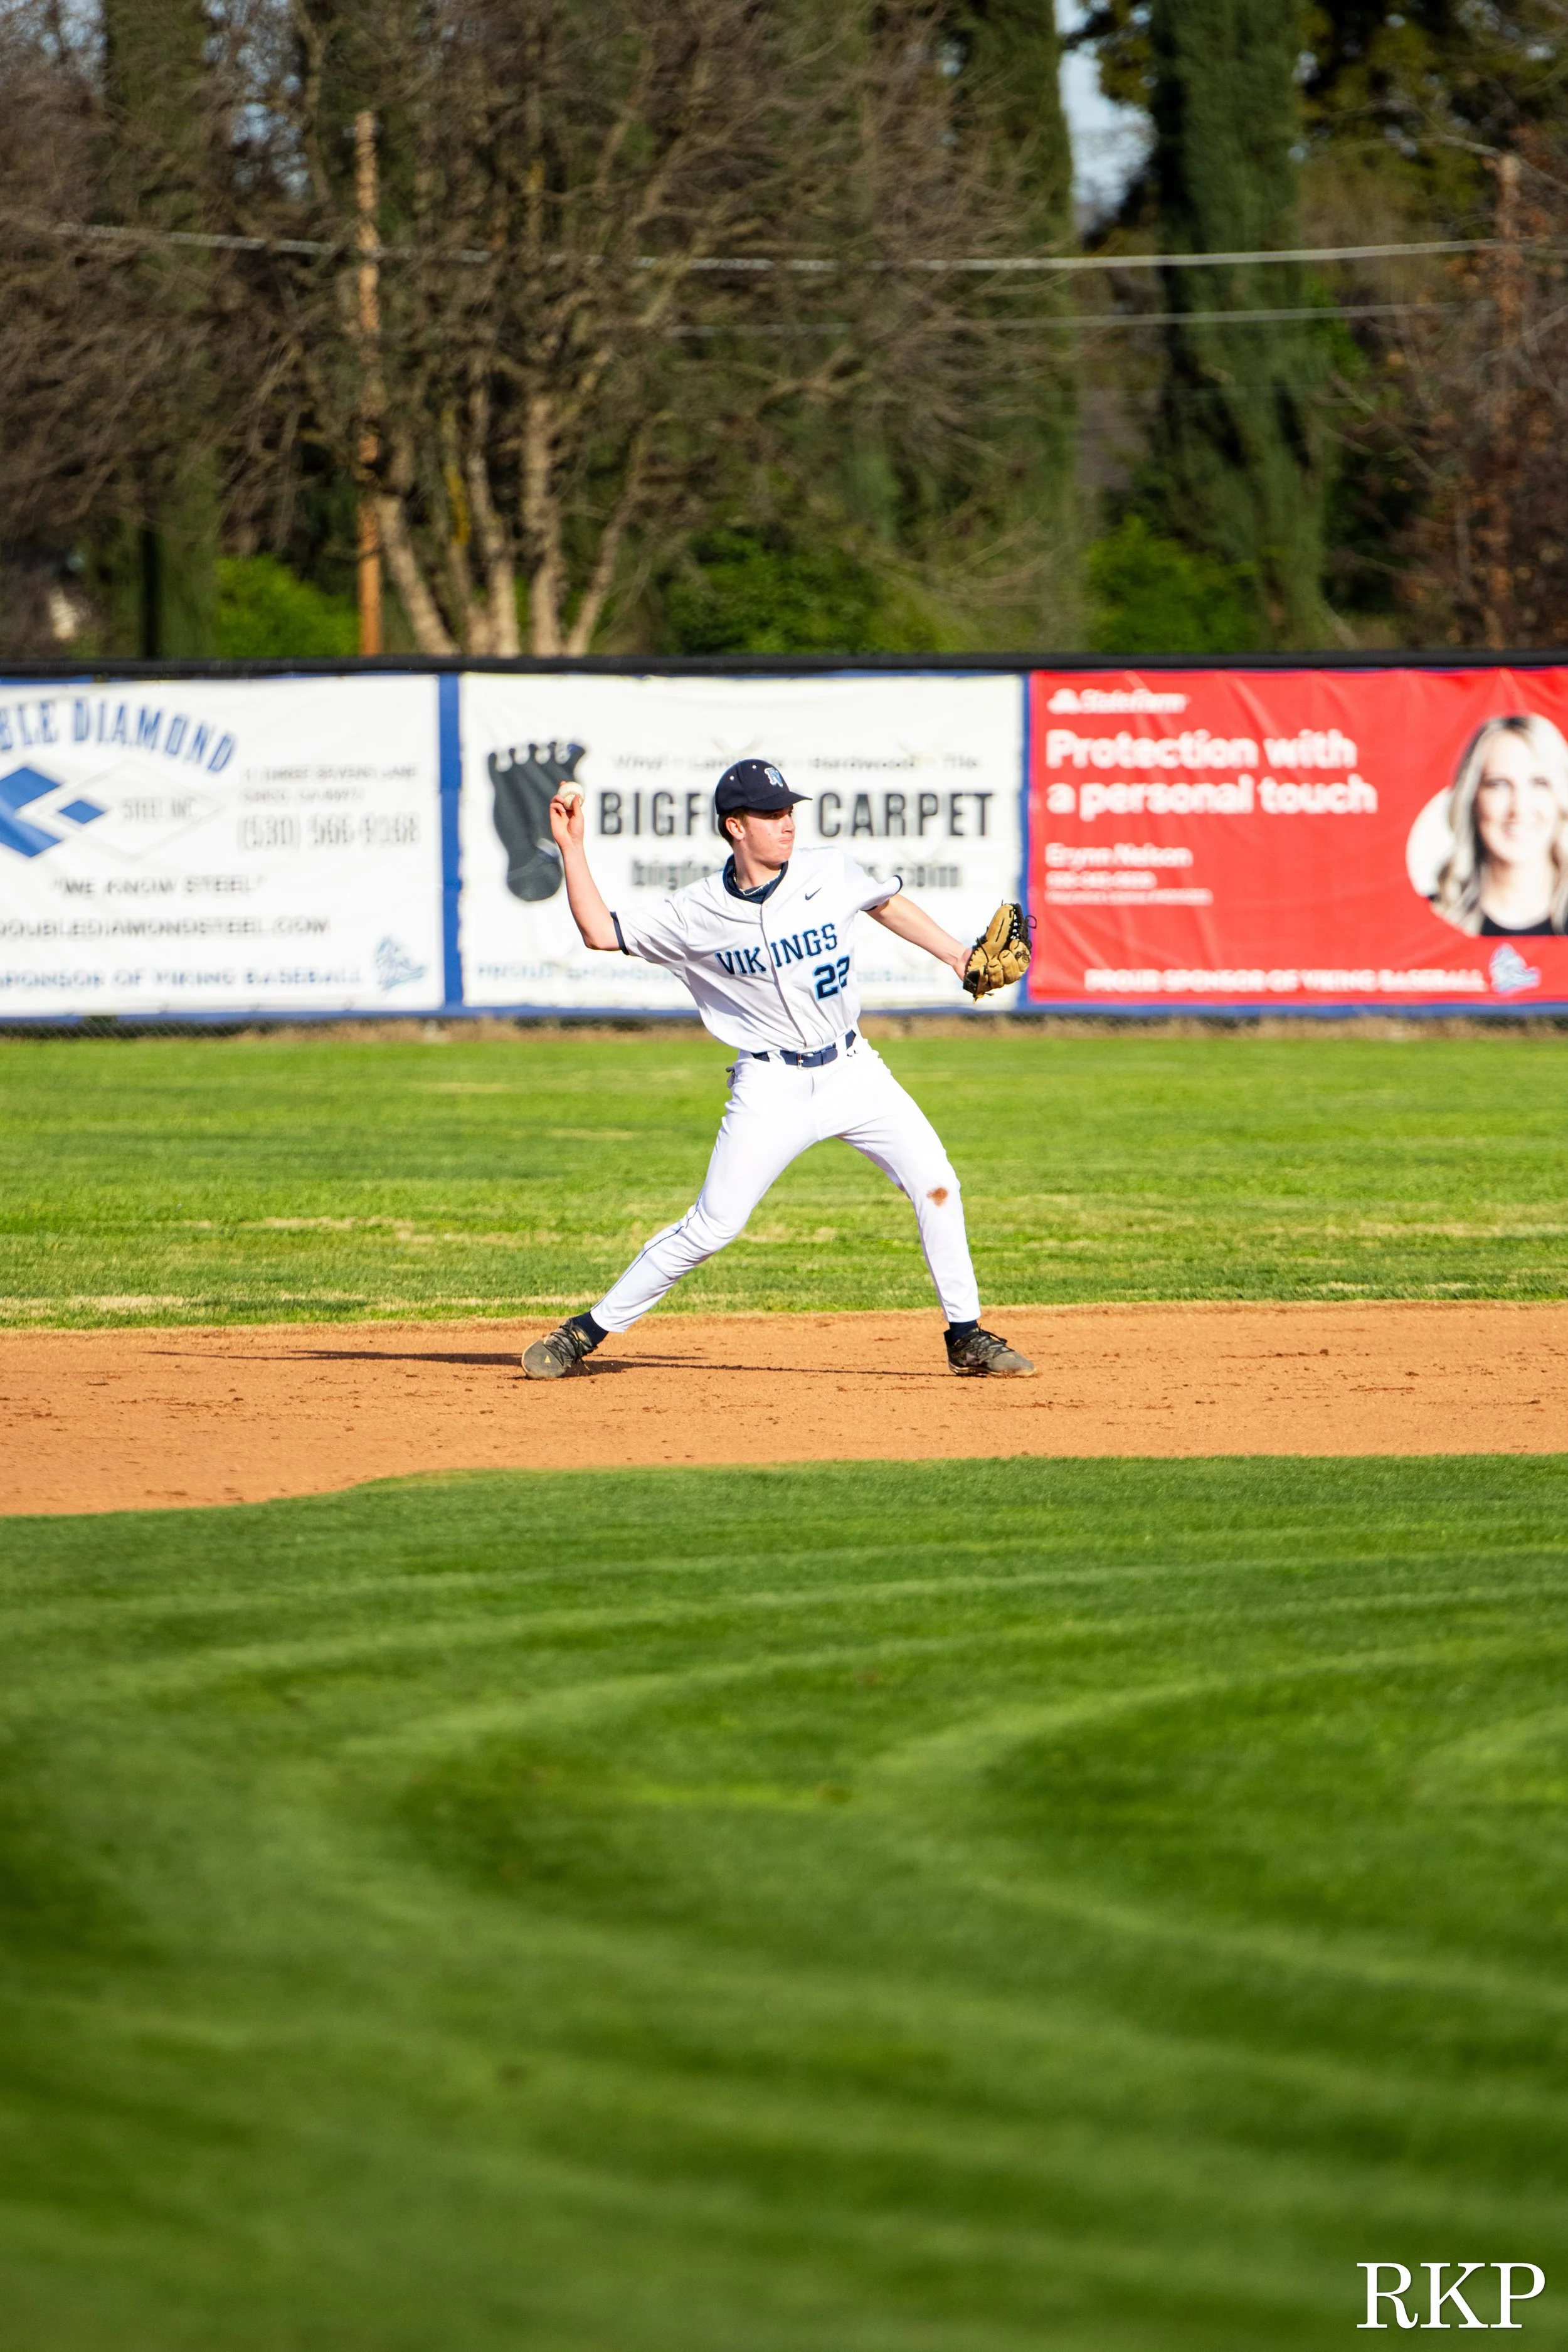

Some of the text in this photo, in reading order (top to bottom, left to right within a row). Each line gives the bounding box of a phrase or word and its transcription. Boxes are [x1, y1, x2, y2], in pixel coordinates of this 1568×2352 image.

[74, 699, 236, 773] DIAMOND
[1046, 729, 1357, 769] Protection with
[122, 797, 164, 821] STEEL
[599, 792, 994, 837] BIGF CARPET
[1047, 775, 1377, 822] a personal touch
[106, 876, 176, 895] KNOW
[715, 923, 838, 975] VIKINGS
[114, 970, 144, 987] OF
[155, 970, 234, 987] VIKING
[245, 968, 362, 985] BASEBALL
[812, 954, 850, 1002] 22
[1085, 969, 1486, 992] PROUD SPONSOR OF VIKING BASEBALL
